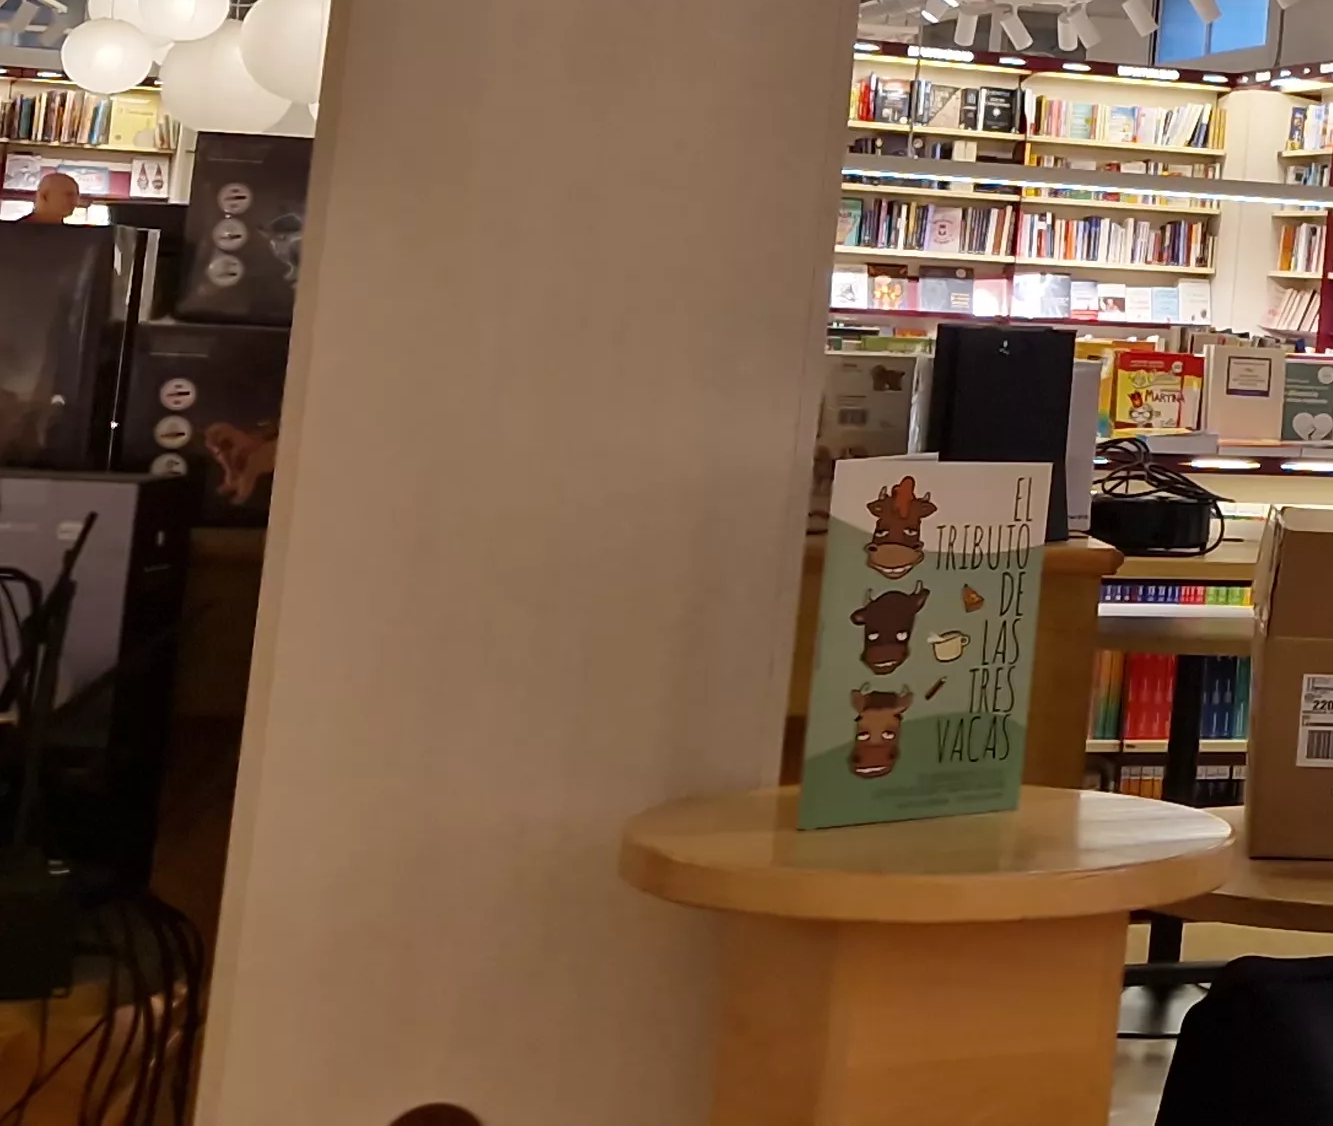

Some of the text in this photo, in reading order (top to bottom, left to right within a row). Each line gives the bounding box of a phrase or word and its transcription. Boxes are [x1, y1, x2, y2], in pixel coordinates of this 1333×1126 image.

[1014, 476, 1034, 522] EL
[935, 522, 1031, 571] TRIBUTO
[1000, 571, 1026, 618] DE
[981, 617, 1020, 666] LAS
[968, 665, 1016, 715] TRES
[937, 713, 1011, 763] VACAS
